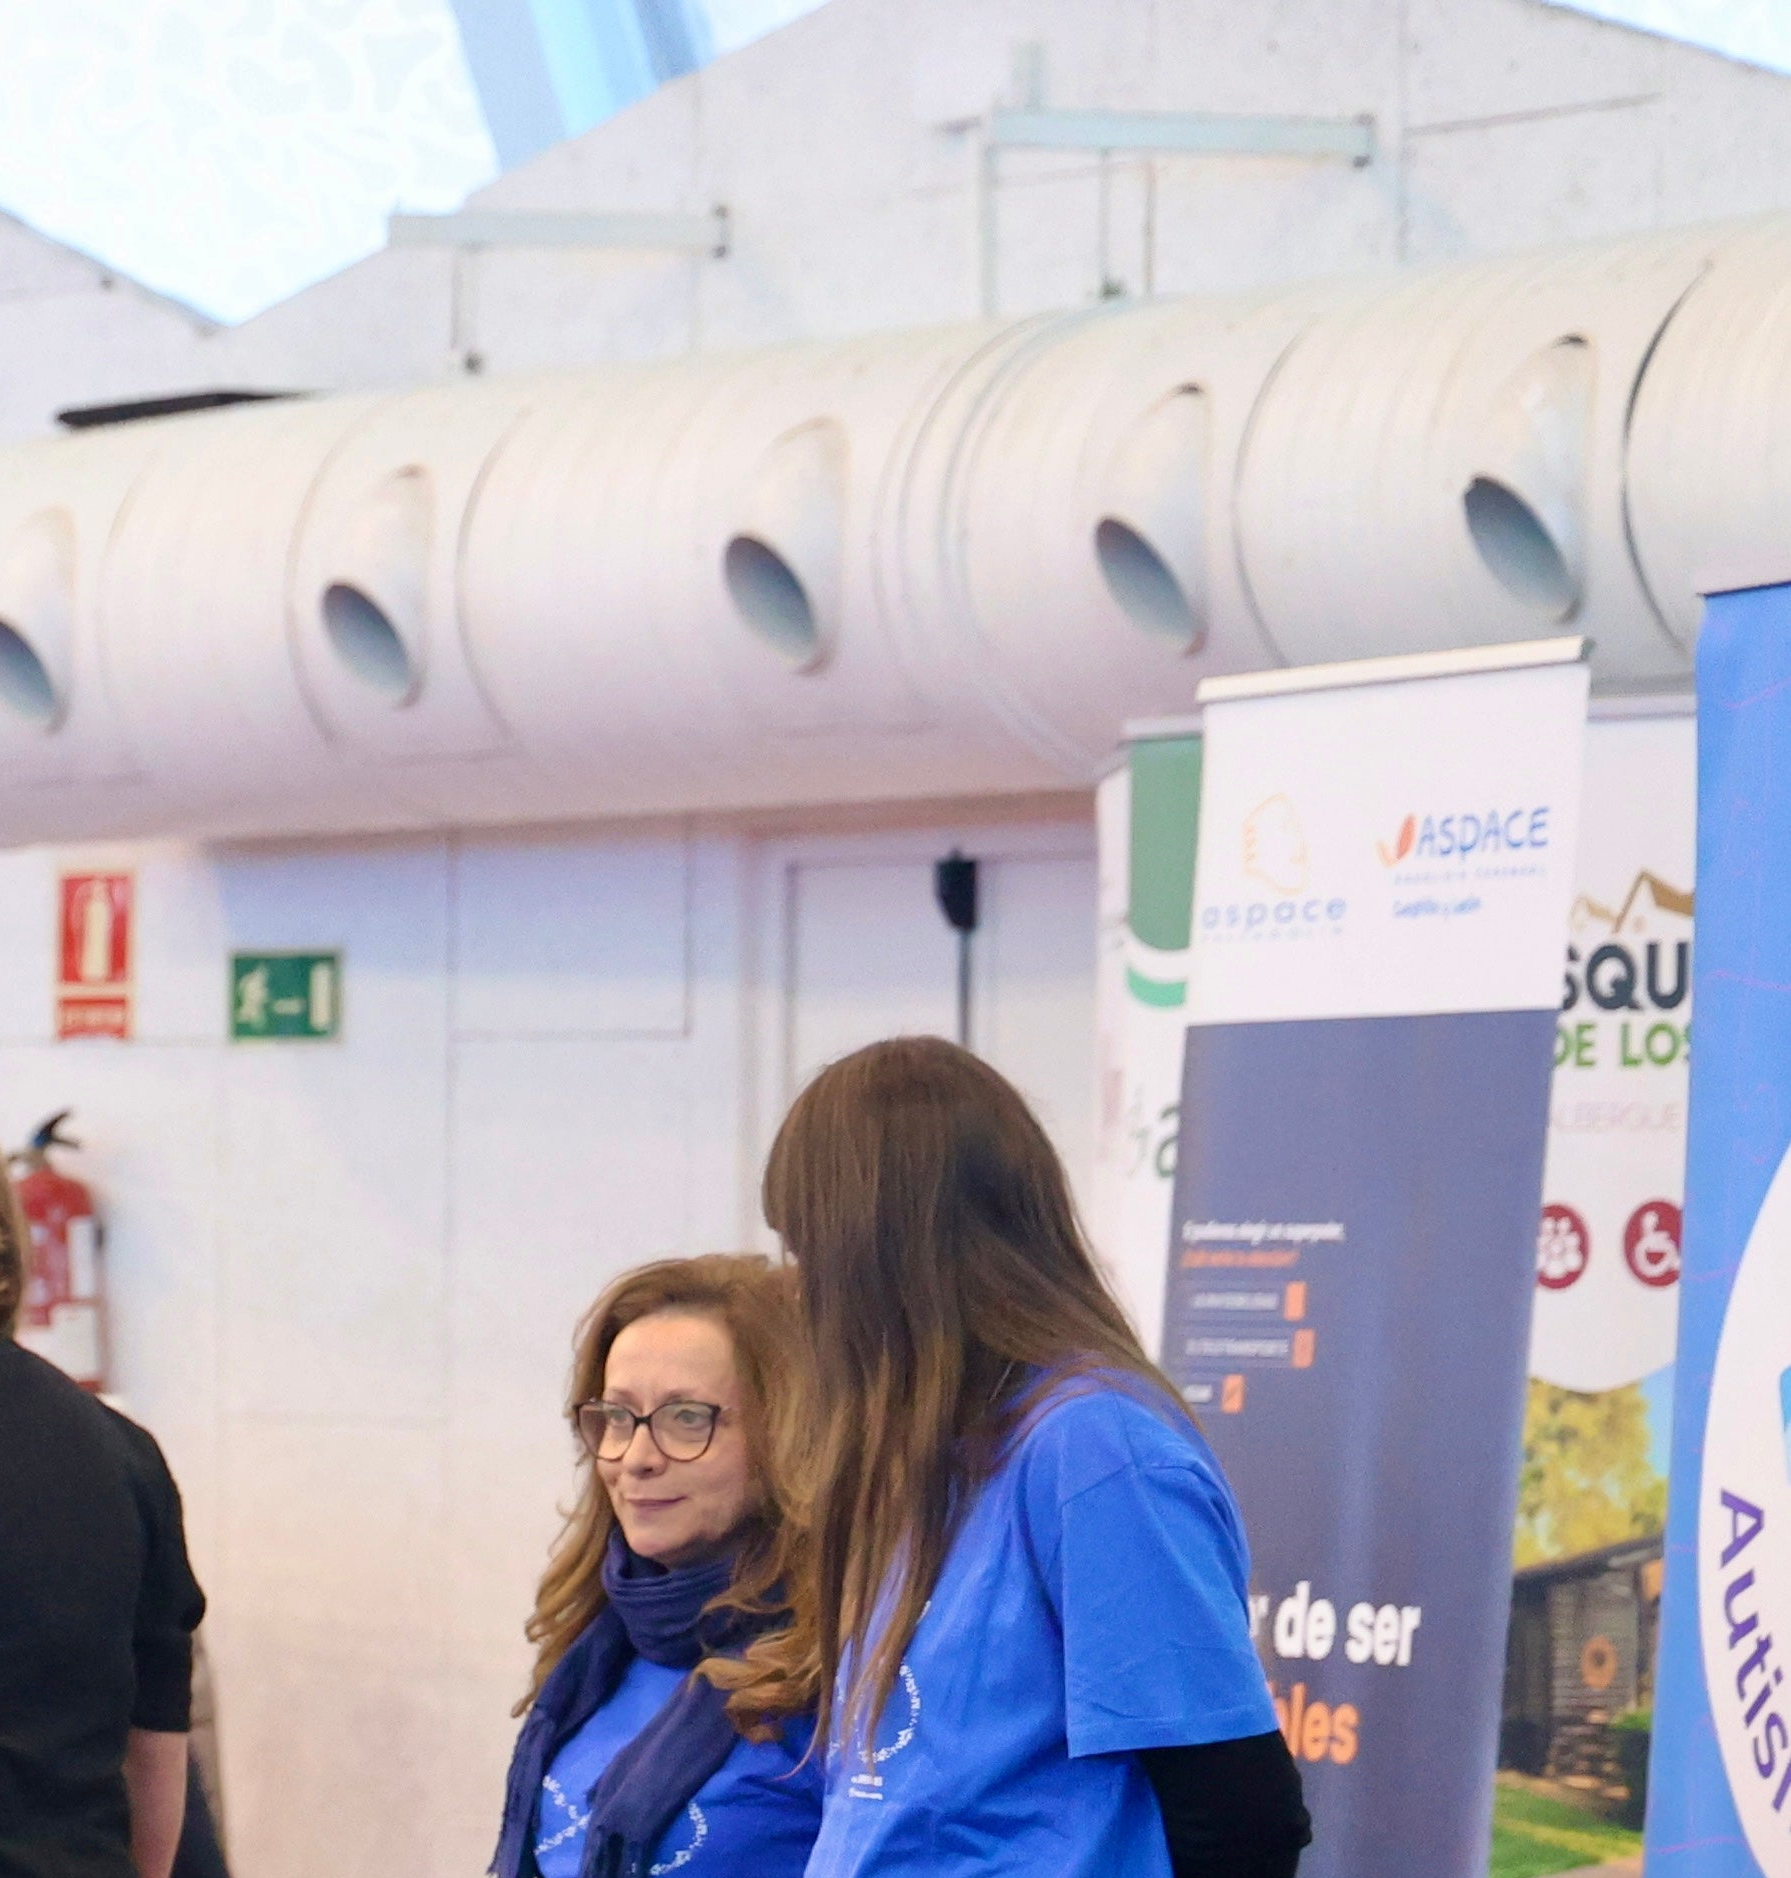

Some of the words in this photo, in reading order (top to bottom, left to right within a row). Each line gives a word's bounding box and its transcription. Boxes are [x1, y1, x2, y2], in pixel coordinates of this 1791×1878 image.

[1418, 806, 1550, 861] ASPACE
[1274, 1580, 1337, 1660] de
[1345, 1602, 1421, 1667] ser
[1719, 1488, 1791, 1812] Autis
